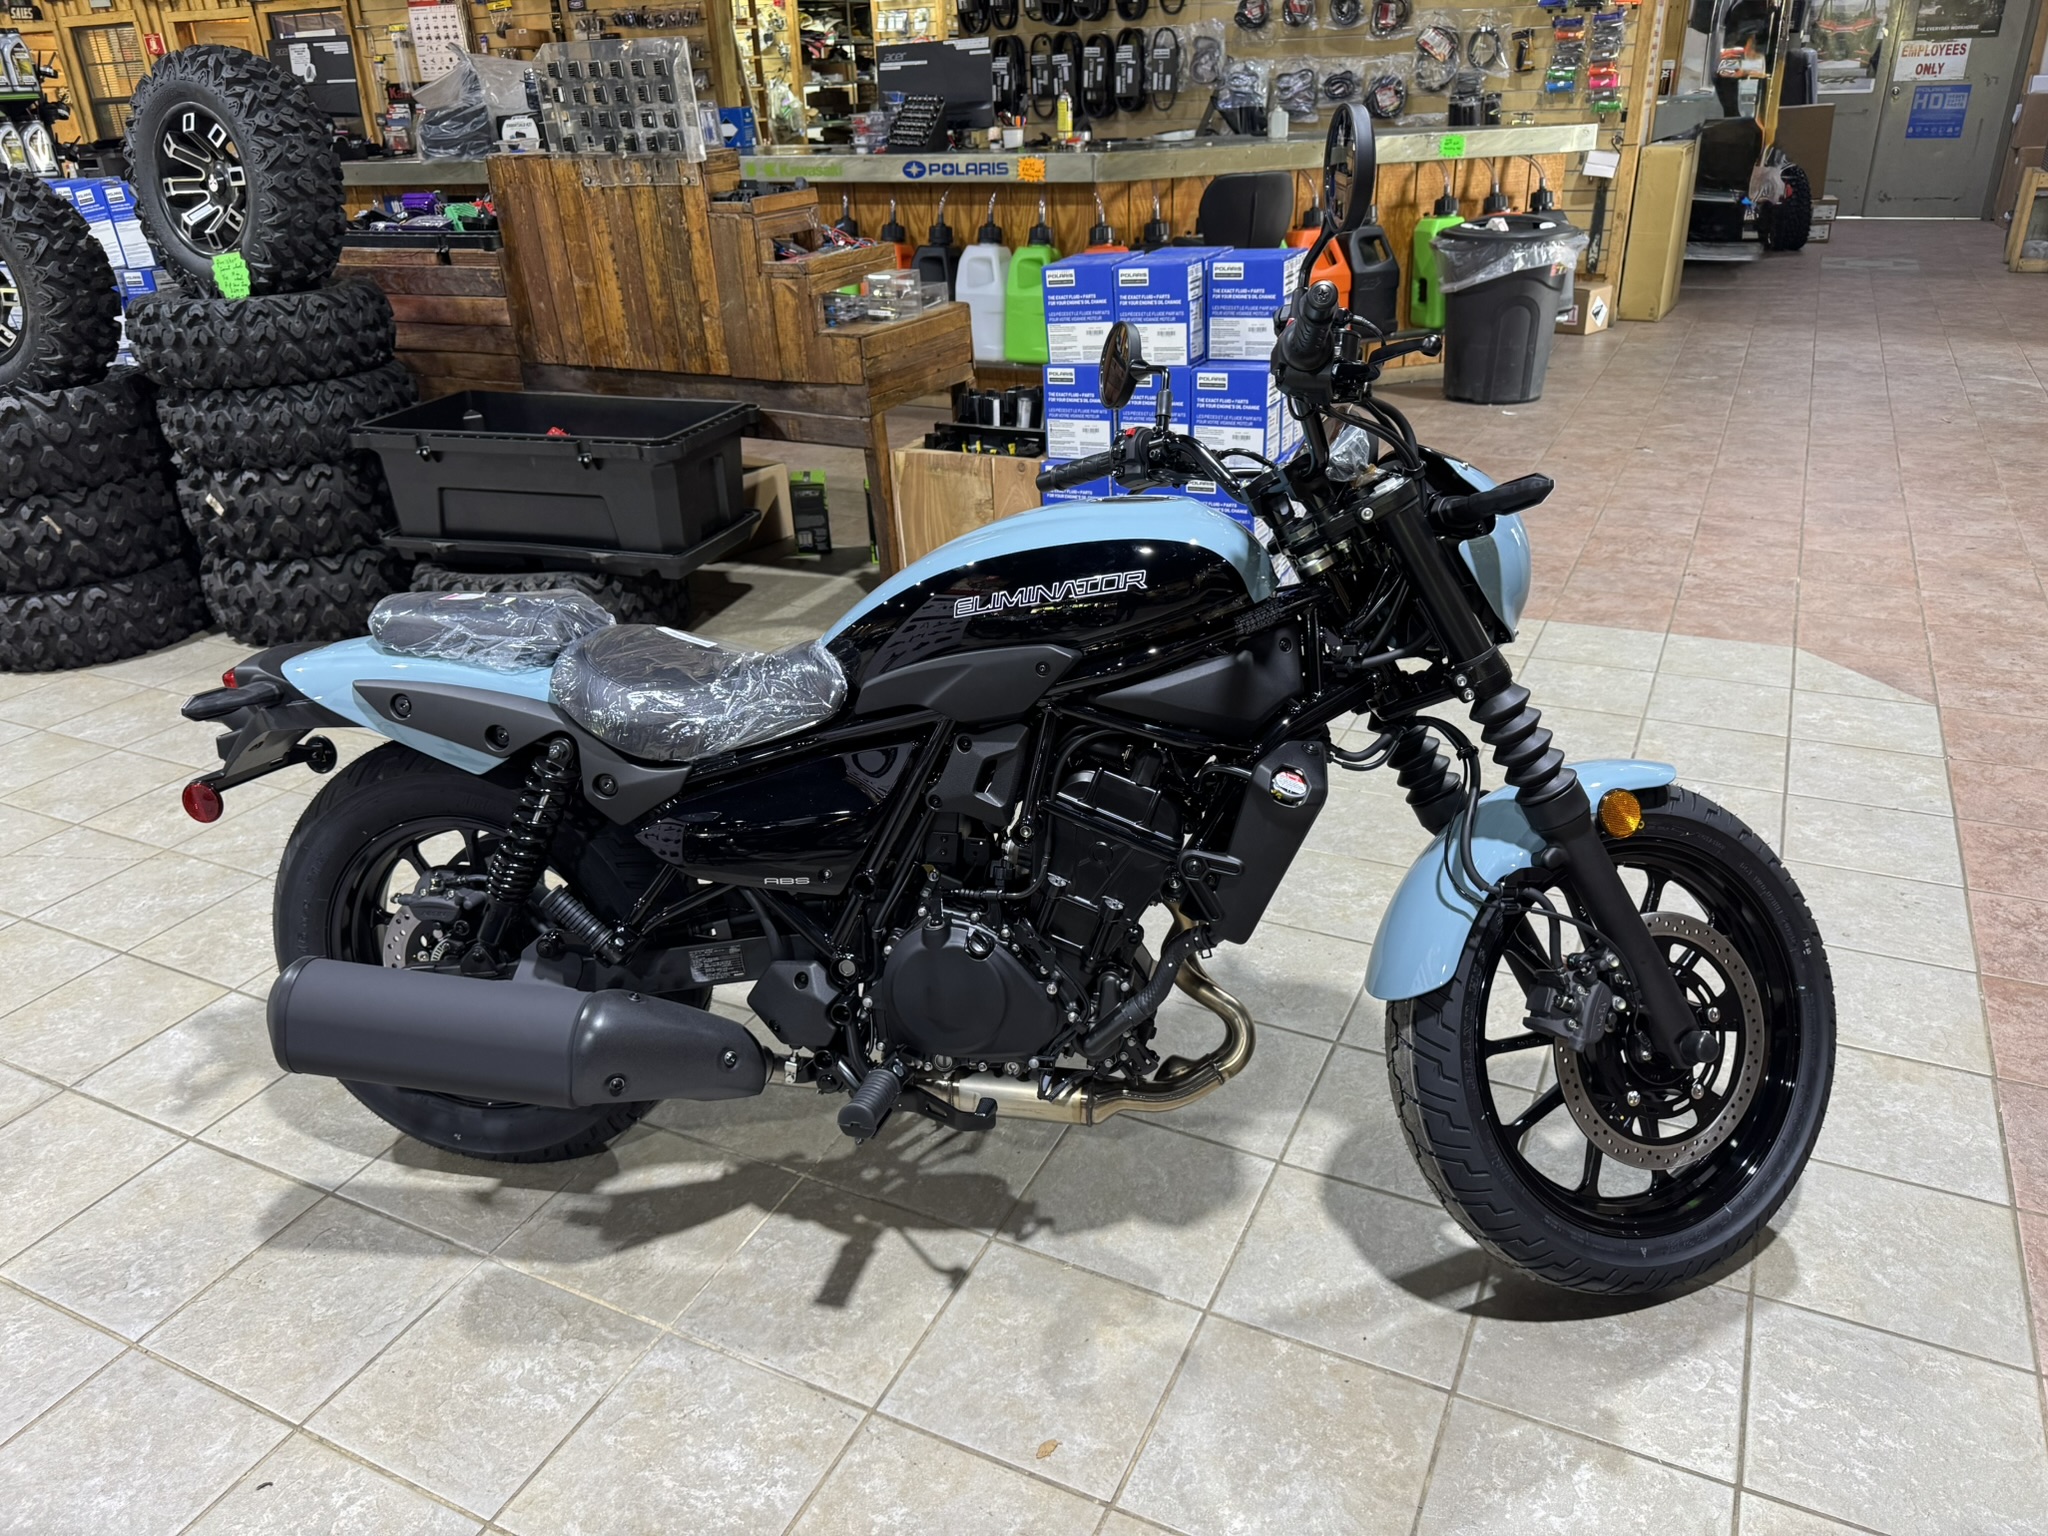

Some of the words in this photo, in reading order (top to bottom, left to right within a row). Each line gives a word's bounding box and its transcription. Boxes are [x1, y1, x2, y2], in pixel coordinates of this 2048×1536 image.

[10, 7, 34, 19] SALES
[884, 52, 907, 62] acer
[1901, 43, 1967, 57] EMPLOYEES
[1915, 62, 1945, 75] ONLY
[1913, 93, 1944, 109] HD
[780, 162, 843, 177] Kawasaki
[928, 162, 1009, 176] POLARIS
[953, 570, 1147, 618] ELIMINATOR
